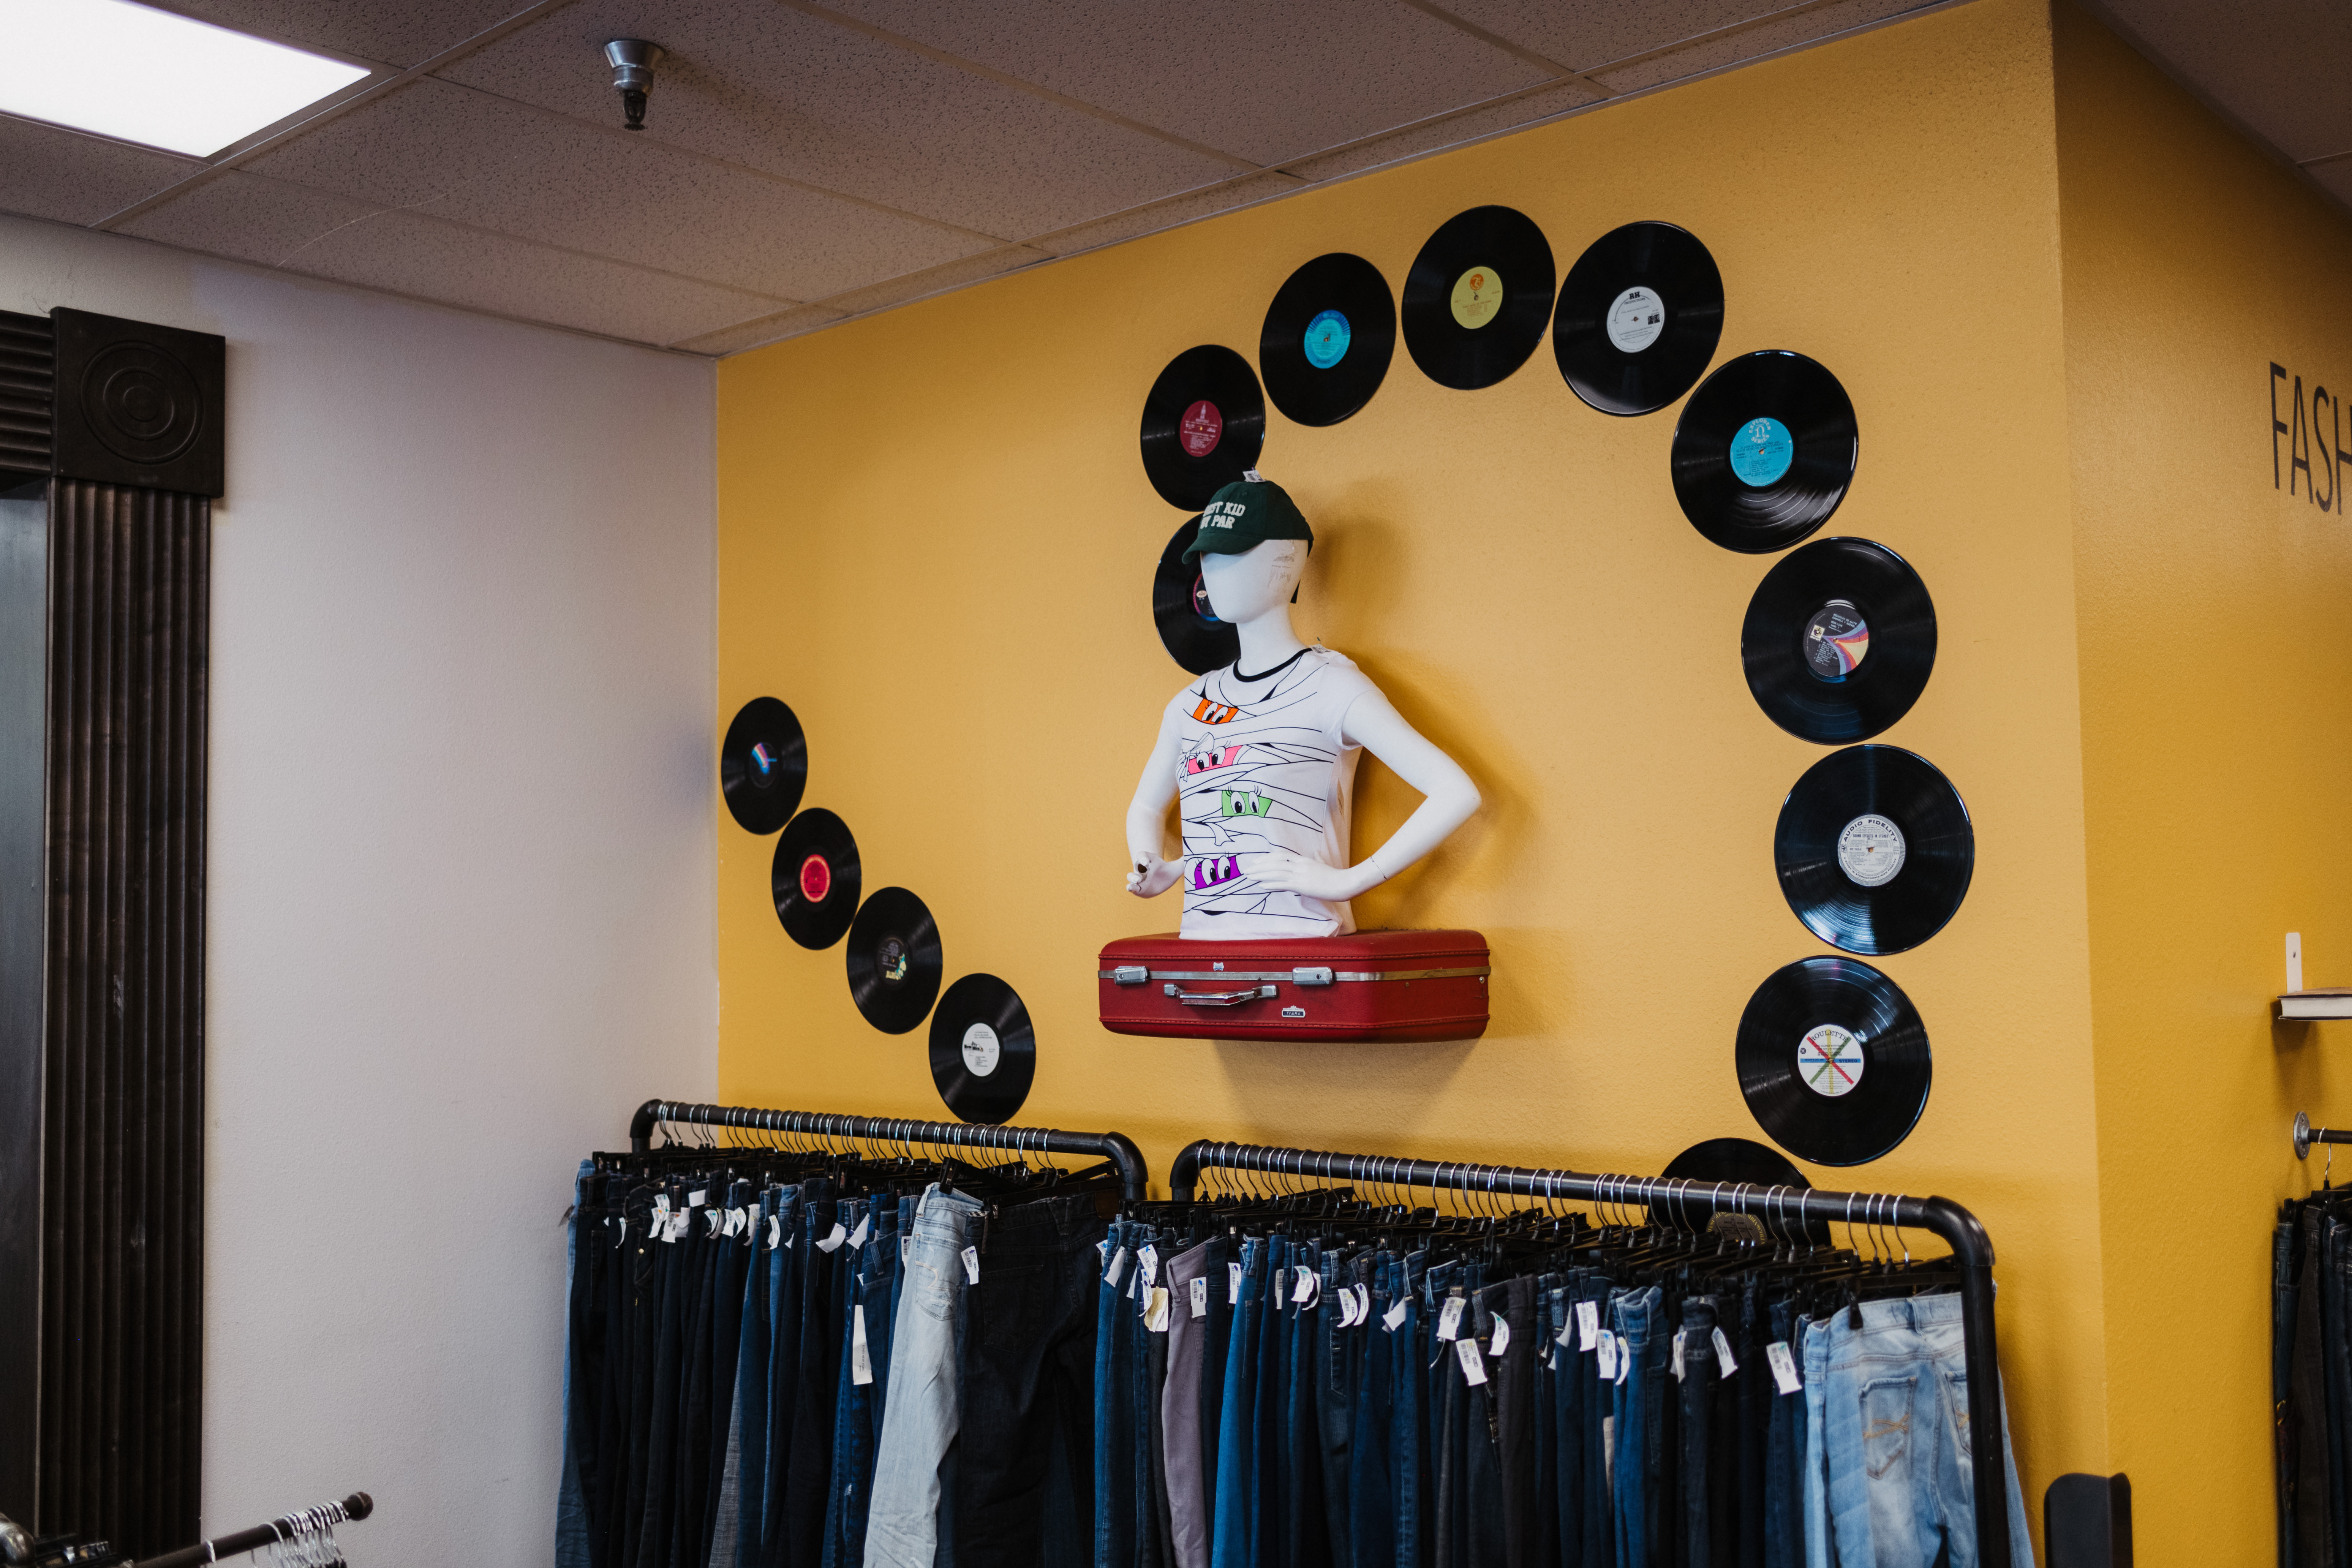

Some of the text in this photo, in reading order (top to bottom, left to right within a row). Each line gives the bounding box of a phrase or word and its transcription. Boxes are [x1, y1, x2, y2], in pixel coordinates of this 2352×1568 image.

[1629, 291, 1640, 300] RH
[1749, 418, 1771, 433] EXPLORER
[1751, 435, 1770, 444] SERIES
[2270, 361, 2352, 515] FASH
[1223, 502, 1246, 517] KID
[1211, 515, 1235, 529] PAR
[1844, 819, 1898, 842] AUDIO FIDELITY
[1810, 1030, 1849, 1043] ROULETTE
